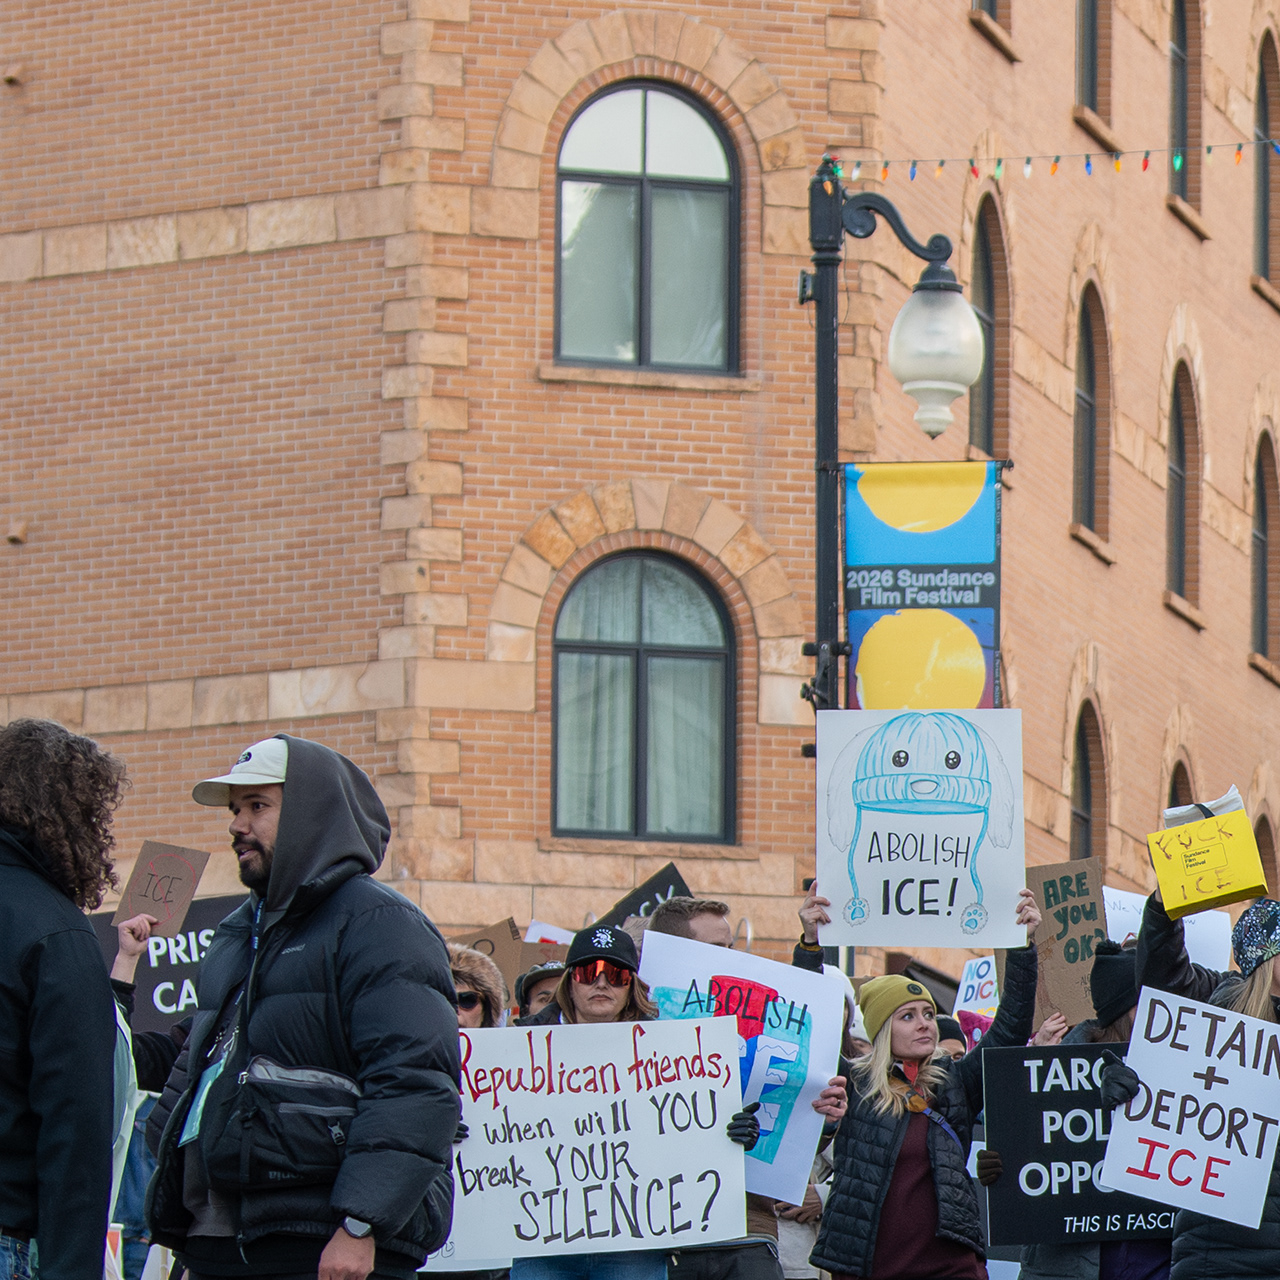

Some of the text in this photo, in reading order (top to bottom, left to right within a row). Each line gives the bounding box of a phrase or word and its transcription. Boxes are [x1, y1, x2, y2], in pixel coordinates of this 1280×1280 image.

[846, 569, 995, 589] 2026 Sundance
[860, 586, 980, 606] Film Festival
[867, 830, 971, 869] ABOLISH
[138, 872, 182, 904] ICE
[882, 877, 959, 917] ICE!
[1042, 871, 1090, 910] ARE
[965, 960, 991, 982] NO
[682, 978, 809, 1035] ABOLISH
[458, 1029, 620, 1110] Republican
[627, 1024, 732, 1094] friends,
[483, 1089, 718, 1145] when will YOU
[1124, 1079, 1279, 1159] DEPORT
[456, 1141, 639, 1196] break YOUR
[1126, 1137, 1231, 1198] ICE
[513, 1169, 722, 1244] SILENCE?
[1063, 1212, 1176, 1233] THIS IS FASCI
